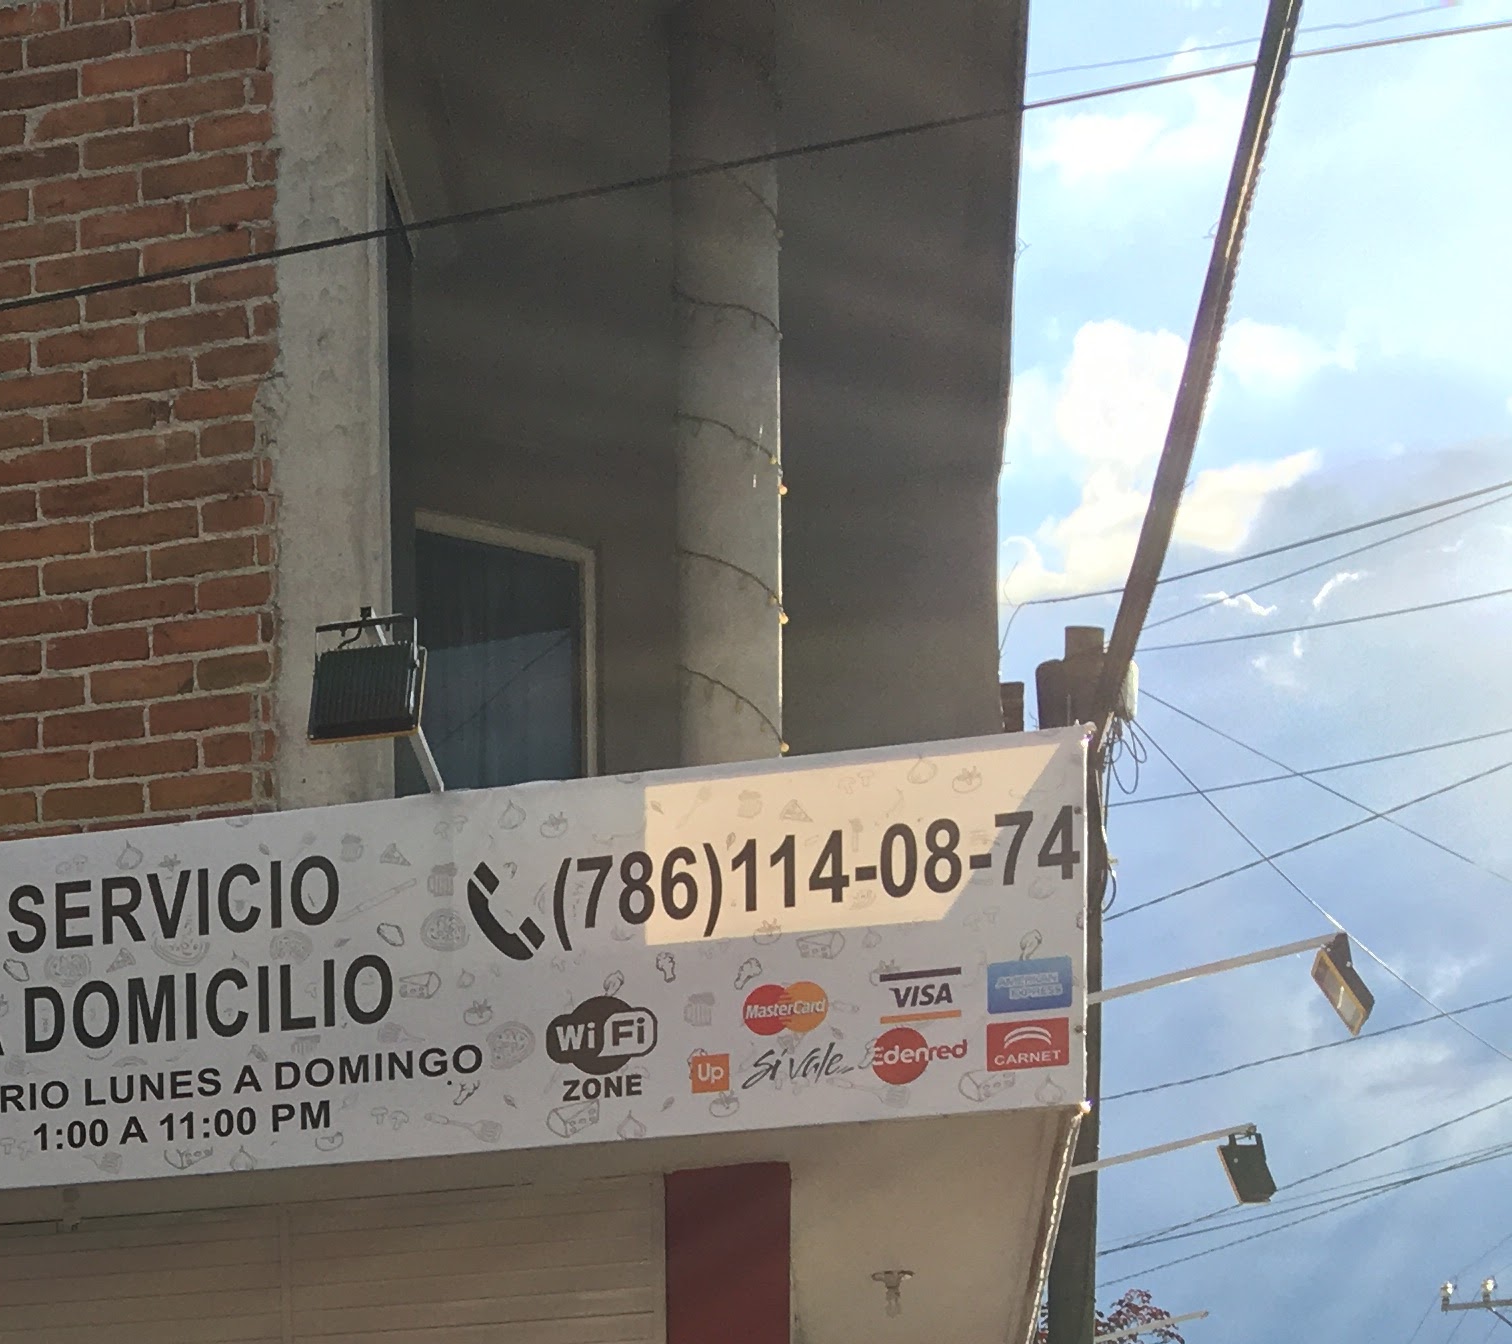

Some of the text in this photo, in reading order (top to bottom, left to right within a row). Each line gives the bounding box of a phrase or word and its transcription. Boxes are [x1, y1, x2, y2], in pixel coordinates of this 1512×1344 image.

[552, 805, 1080, 950] (786)114-08-74
[6, 855, 339, 954] SERVICIO
[25, 954, 393, 1054] DOMICILIO
[745, 998, 827, 1019] MasterCard
[889, 983, 953, 1008] VISA
[85, 1066, 221, 1106] LUNES
[234, 1065, 262, 1094] A
[274, 1044, 483, 1089] DOMINGO
[697, 1063, 724, 1084] Up
[994, 1050, 1061, 1066] CARNET
[563, 1074, 642, 1101] ZONE
[34, 1100, 331, 1151] 1:00 A 11:00 PM
